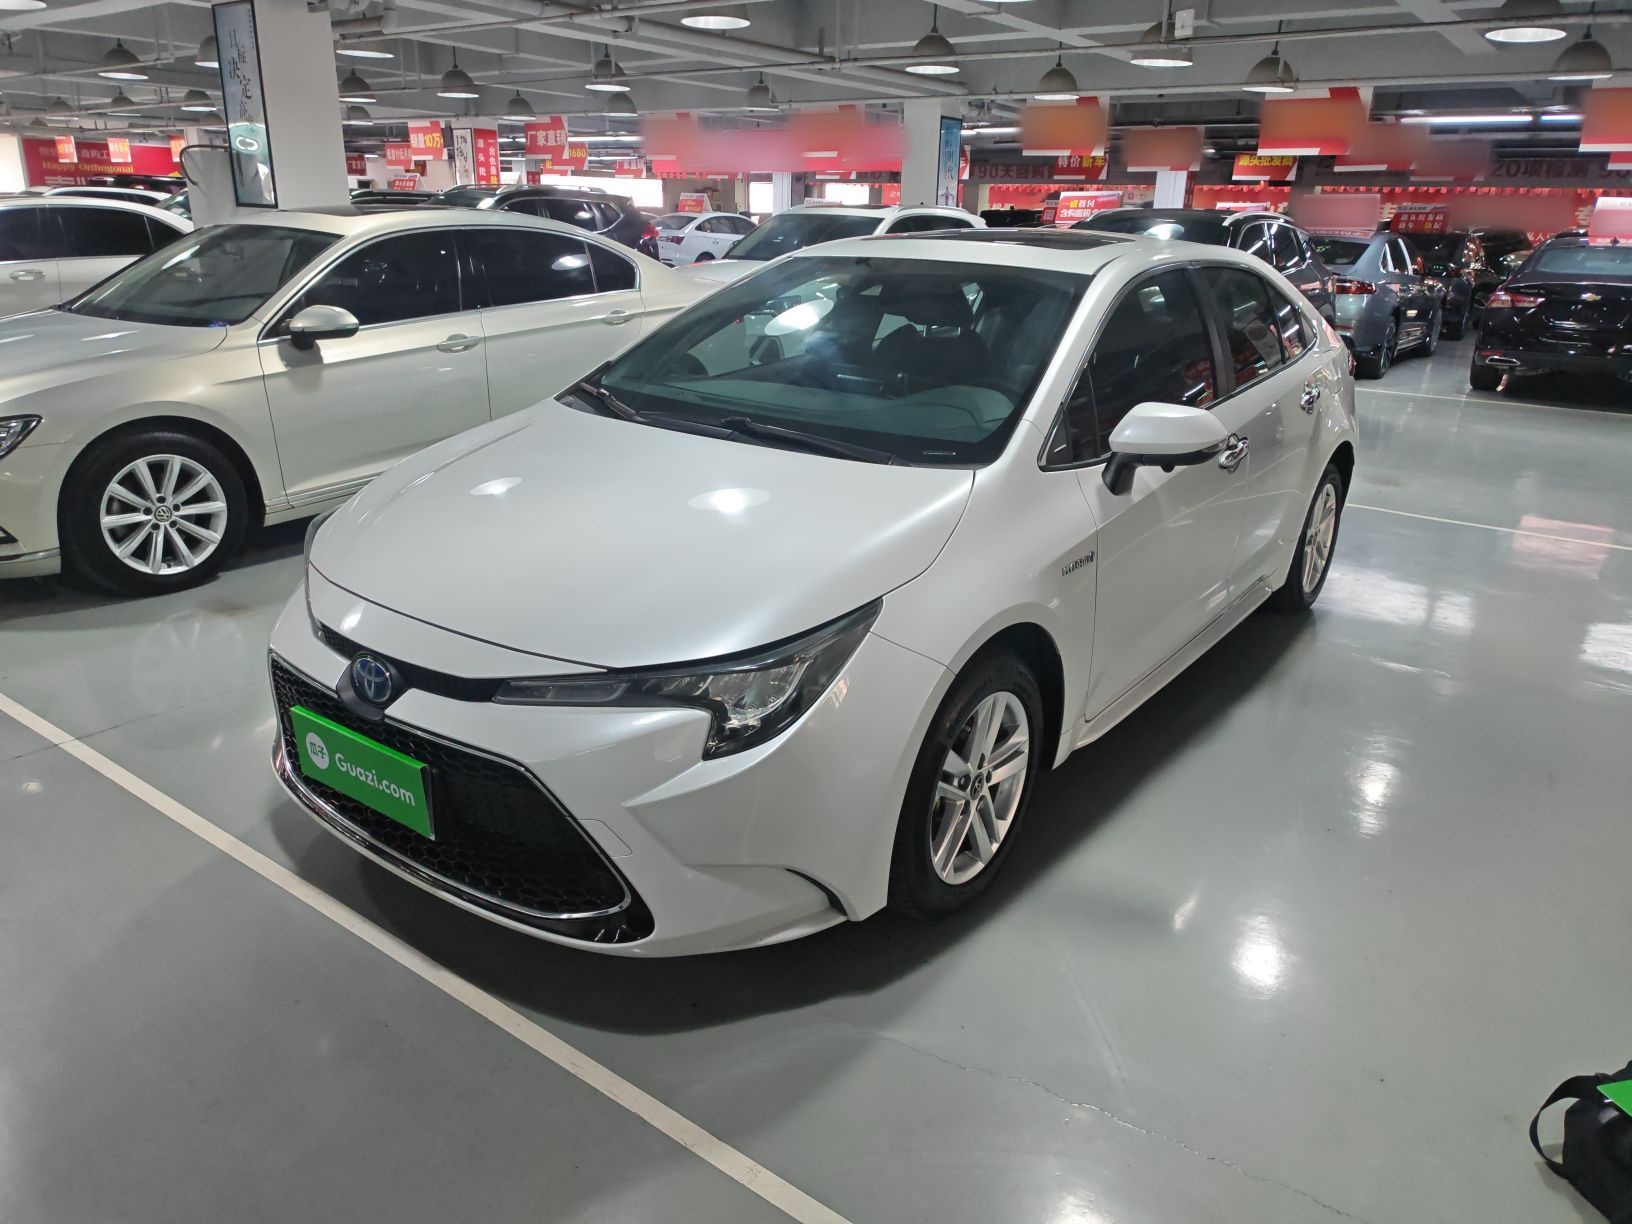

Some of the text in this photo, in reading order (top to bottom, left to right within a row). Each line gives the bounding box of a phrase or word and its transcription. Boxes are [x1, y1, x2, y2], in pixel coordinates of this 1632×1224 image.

[527, 130, 568, 146] 厂家直销
[569, 148, 587, 158] 1680
[79, 161, 135, 174] Orthogonal
[1057, 155, 1105, 169] 特价新车
[1239, 155, 1293, 167] 源头批发商
[335, 753, 416, 807] Guazi.com
